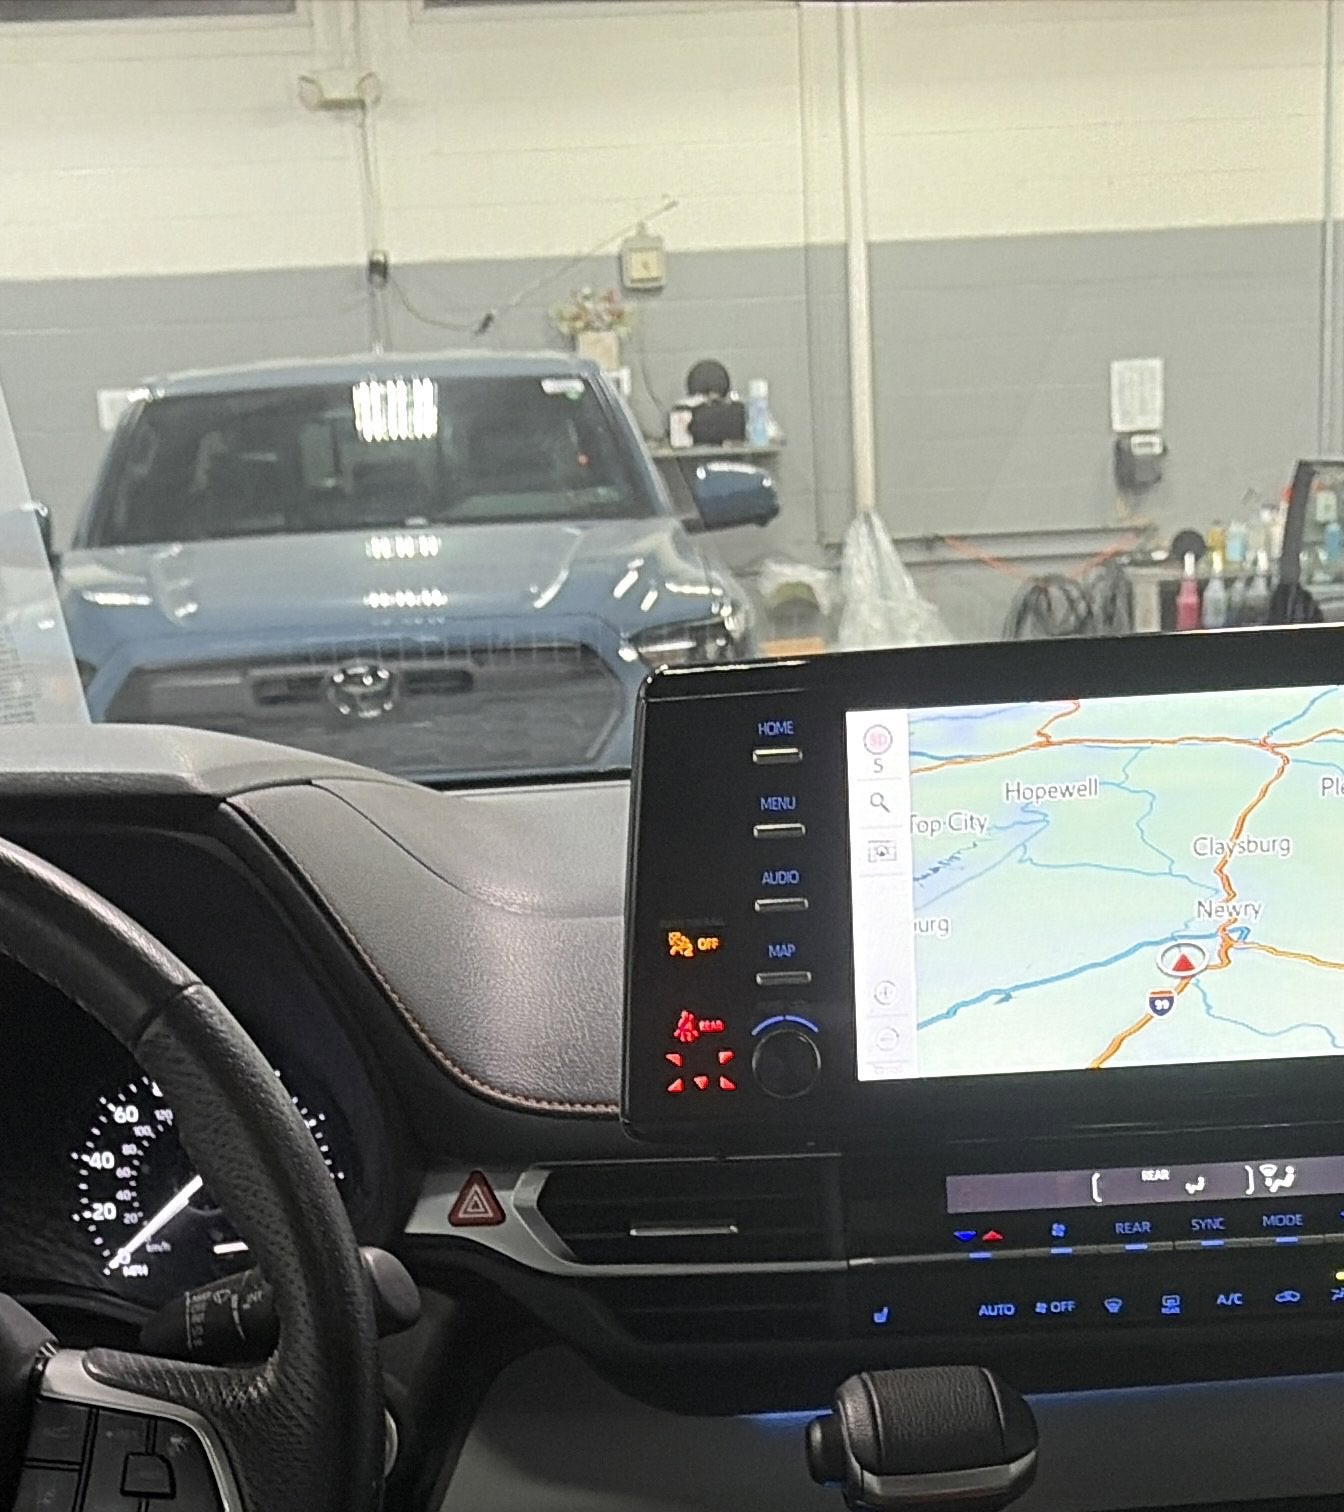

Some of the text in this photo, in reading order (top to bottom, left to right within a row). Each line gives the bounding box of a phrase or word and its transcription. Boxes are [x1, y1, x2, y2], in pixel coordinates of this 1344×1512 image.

[758, 720, 794, 735] HOME
[1005, 778, 1098, 804] Hopewell
[760, 796, 796, 811] MENU
[948, 811, 988, 834] City
[1193, 836, 1291, 858] Claysburg
[762, 870, 800, 884] AUDIO
[1196, 900, 1263, 923] Newry
[696, 936, 720, 950] OFF
[768, 944, 796, 957] MAP
[113, 1105, 139, 1124] 60
[132, 1125, 154, 1138] 100
[88, 1152, 115, 1169] 40
[1141, 1169, 1170, 1181] REAR
[91, 1202, 117, 1220] 20
[122, 1212, 139, 1225] 20
[1191, 1217, 1226, 1231] SYNC
[1262, 1213, 1304, 1227] MODE
[1115, 1221, 1152, 1235] REAR
[1216, 1292, 1243, 1305] A/C
[978, 1303, 1016, 1317] AUTO
[1050, 1300, 1077, 1313] OFF
